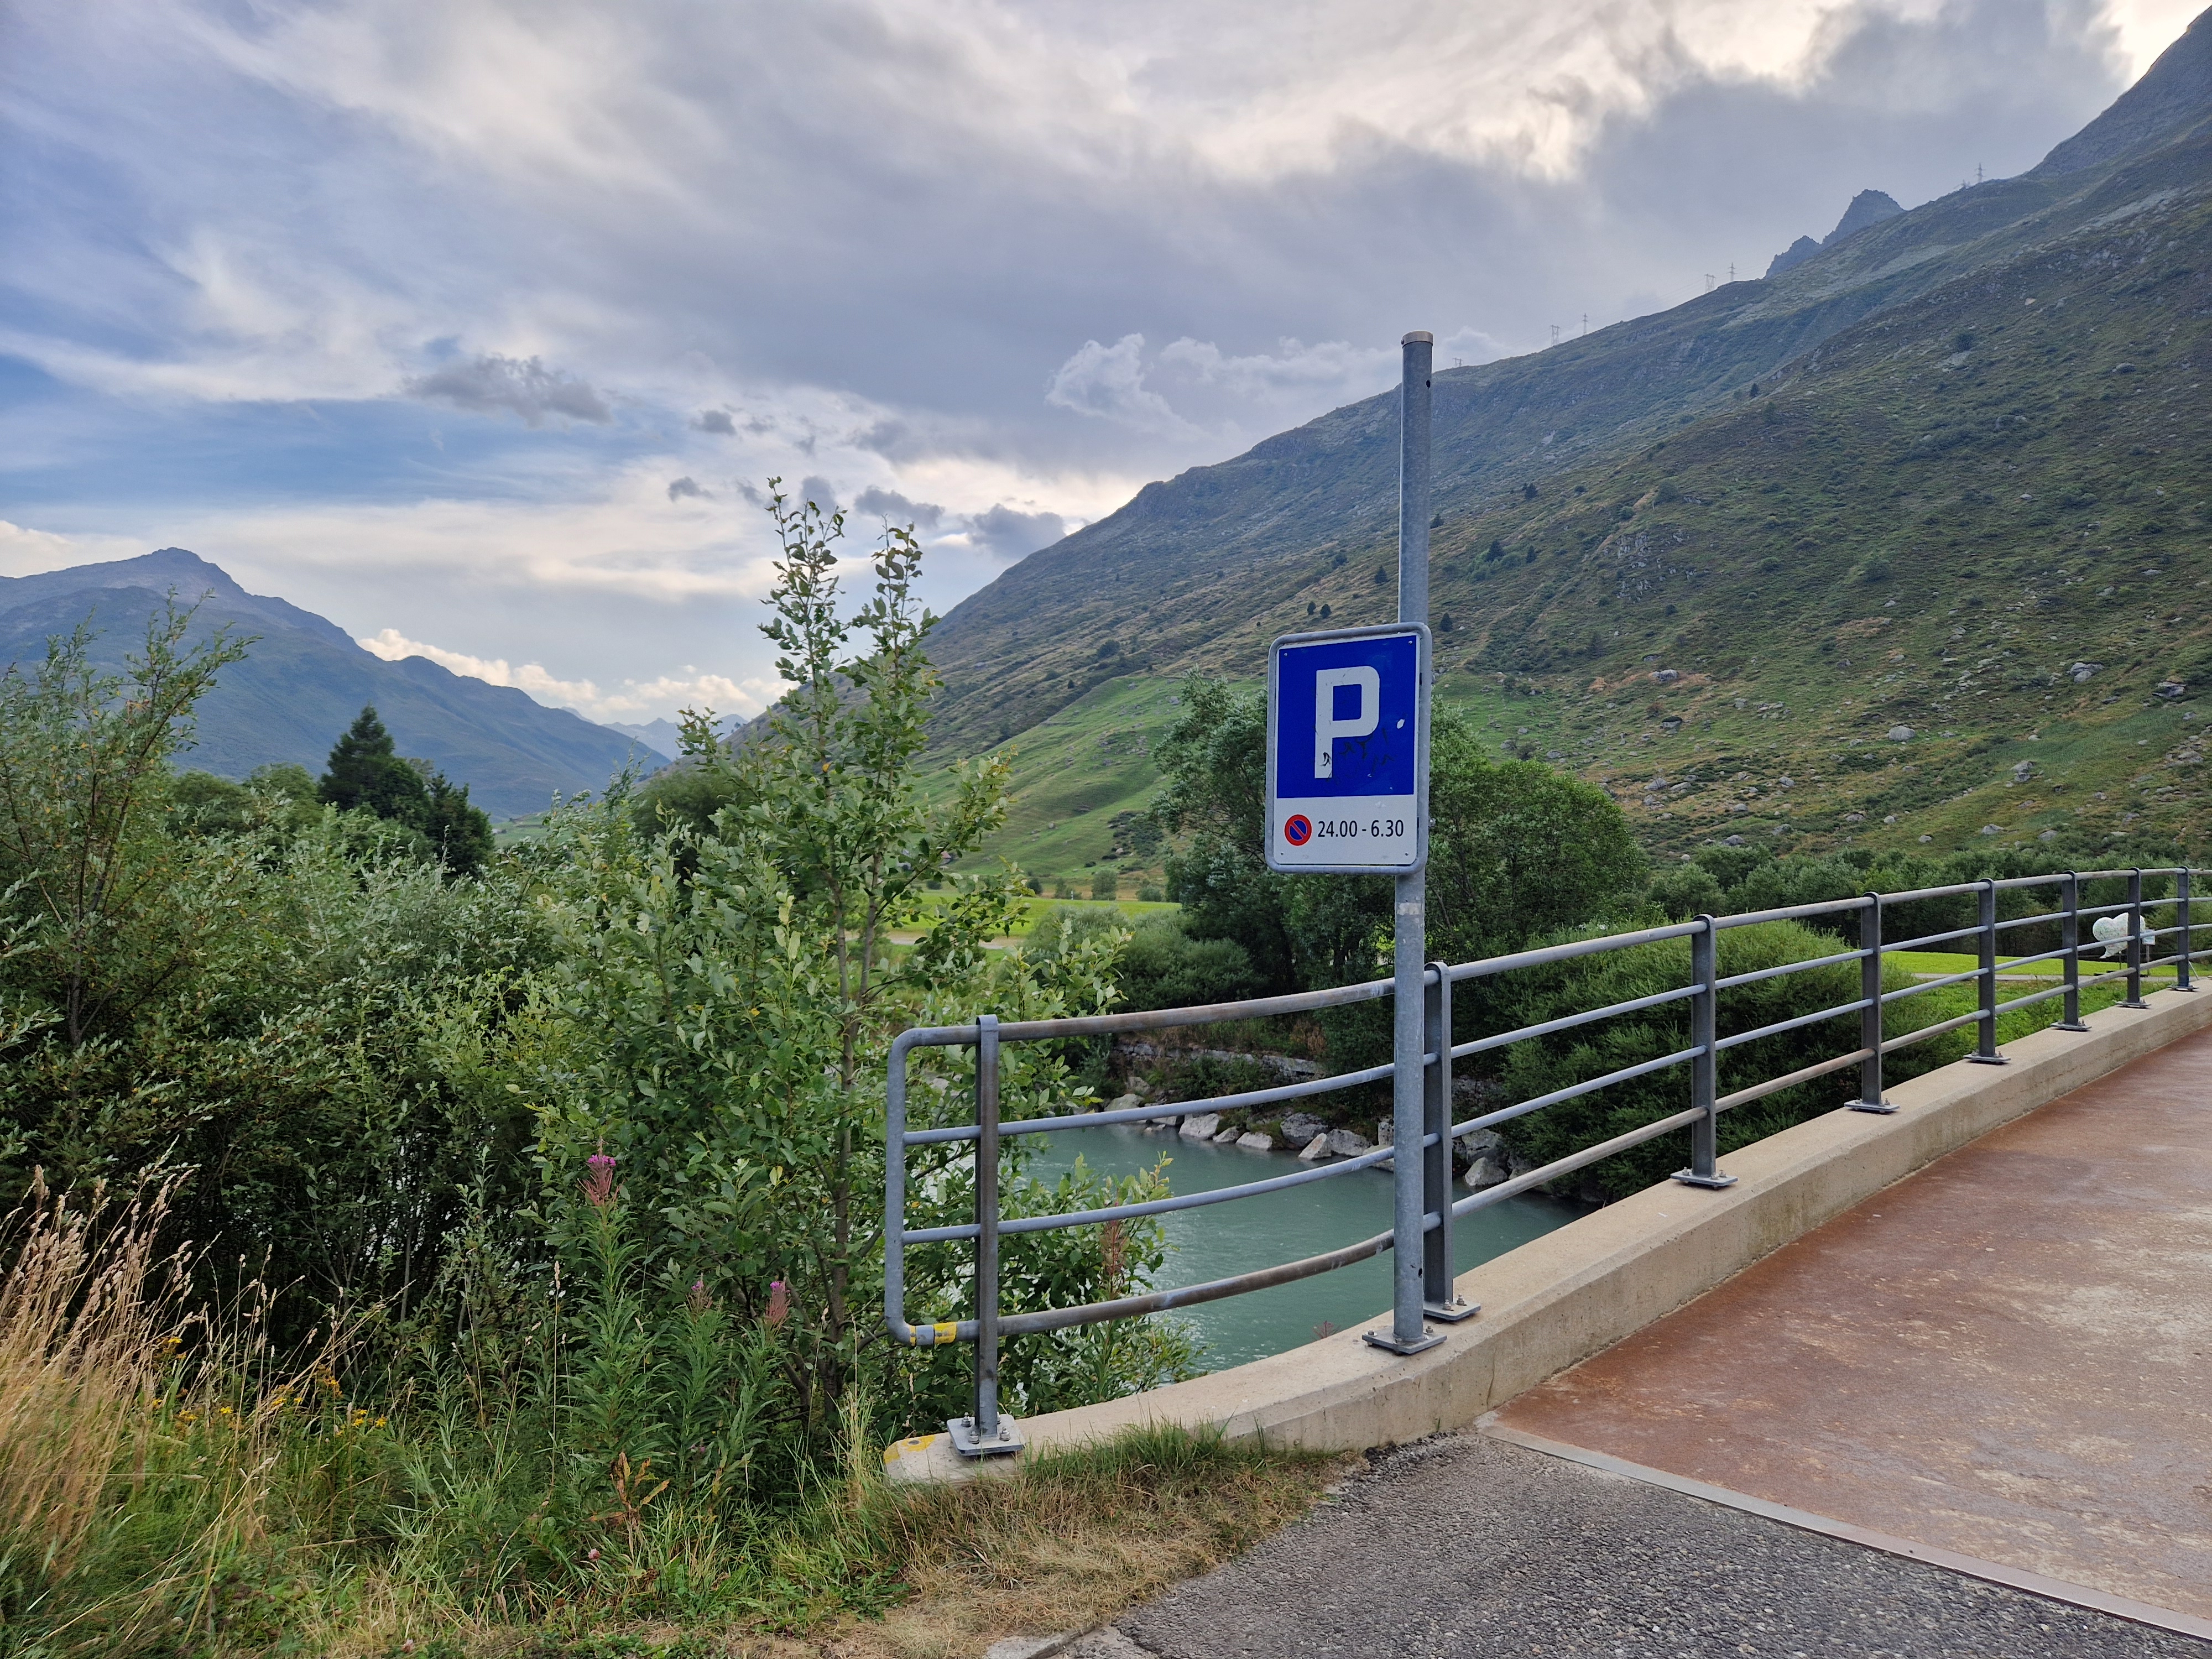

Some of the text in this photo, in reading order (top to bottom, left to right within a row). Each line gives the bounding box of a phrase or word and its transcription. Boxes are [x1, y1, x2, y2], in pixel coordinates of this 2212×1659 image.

[1314, 666, 1380, 779] P
[1318, 820, 1358, 837] 24.00
[1371, 820, 1404, 837] 6.30
